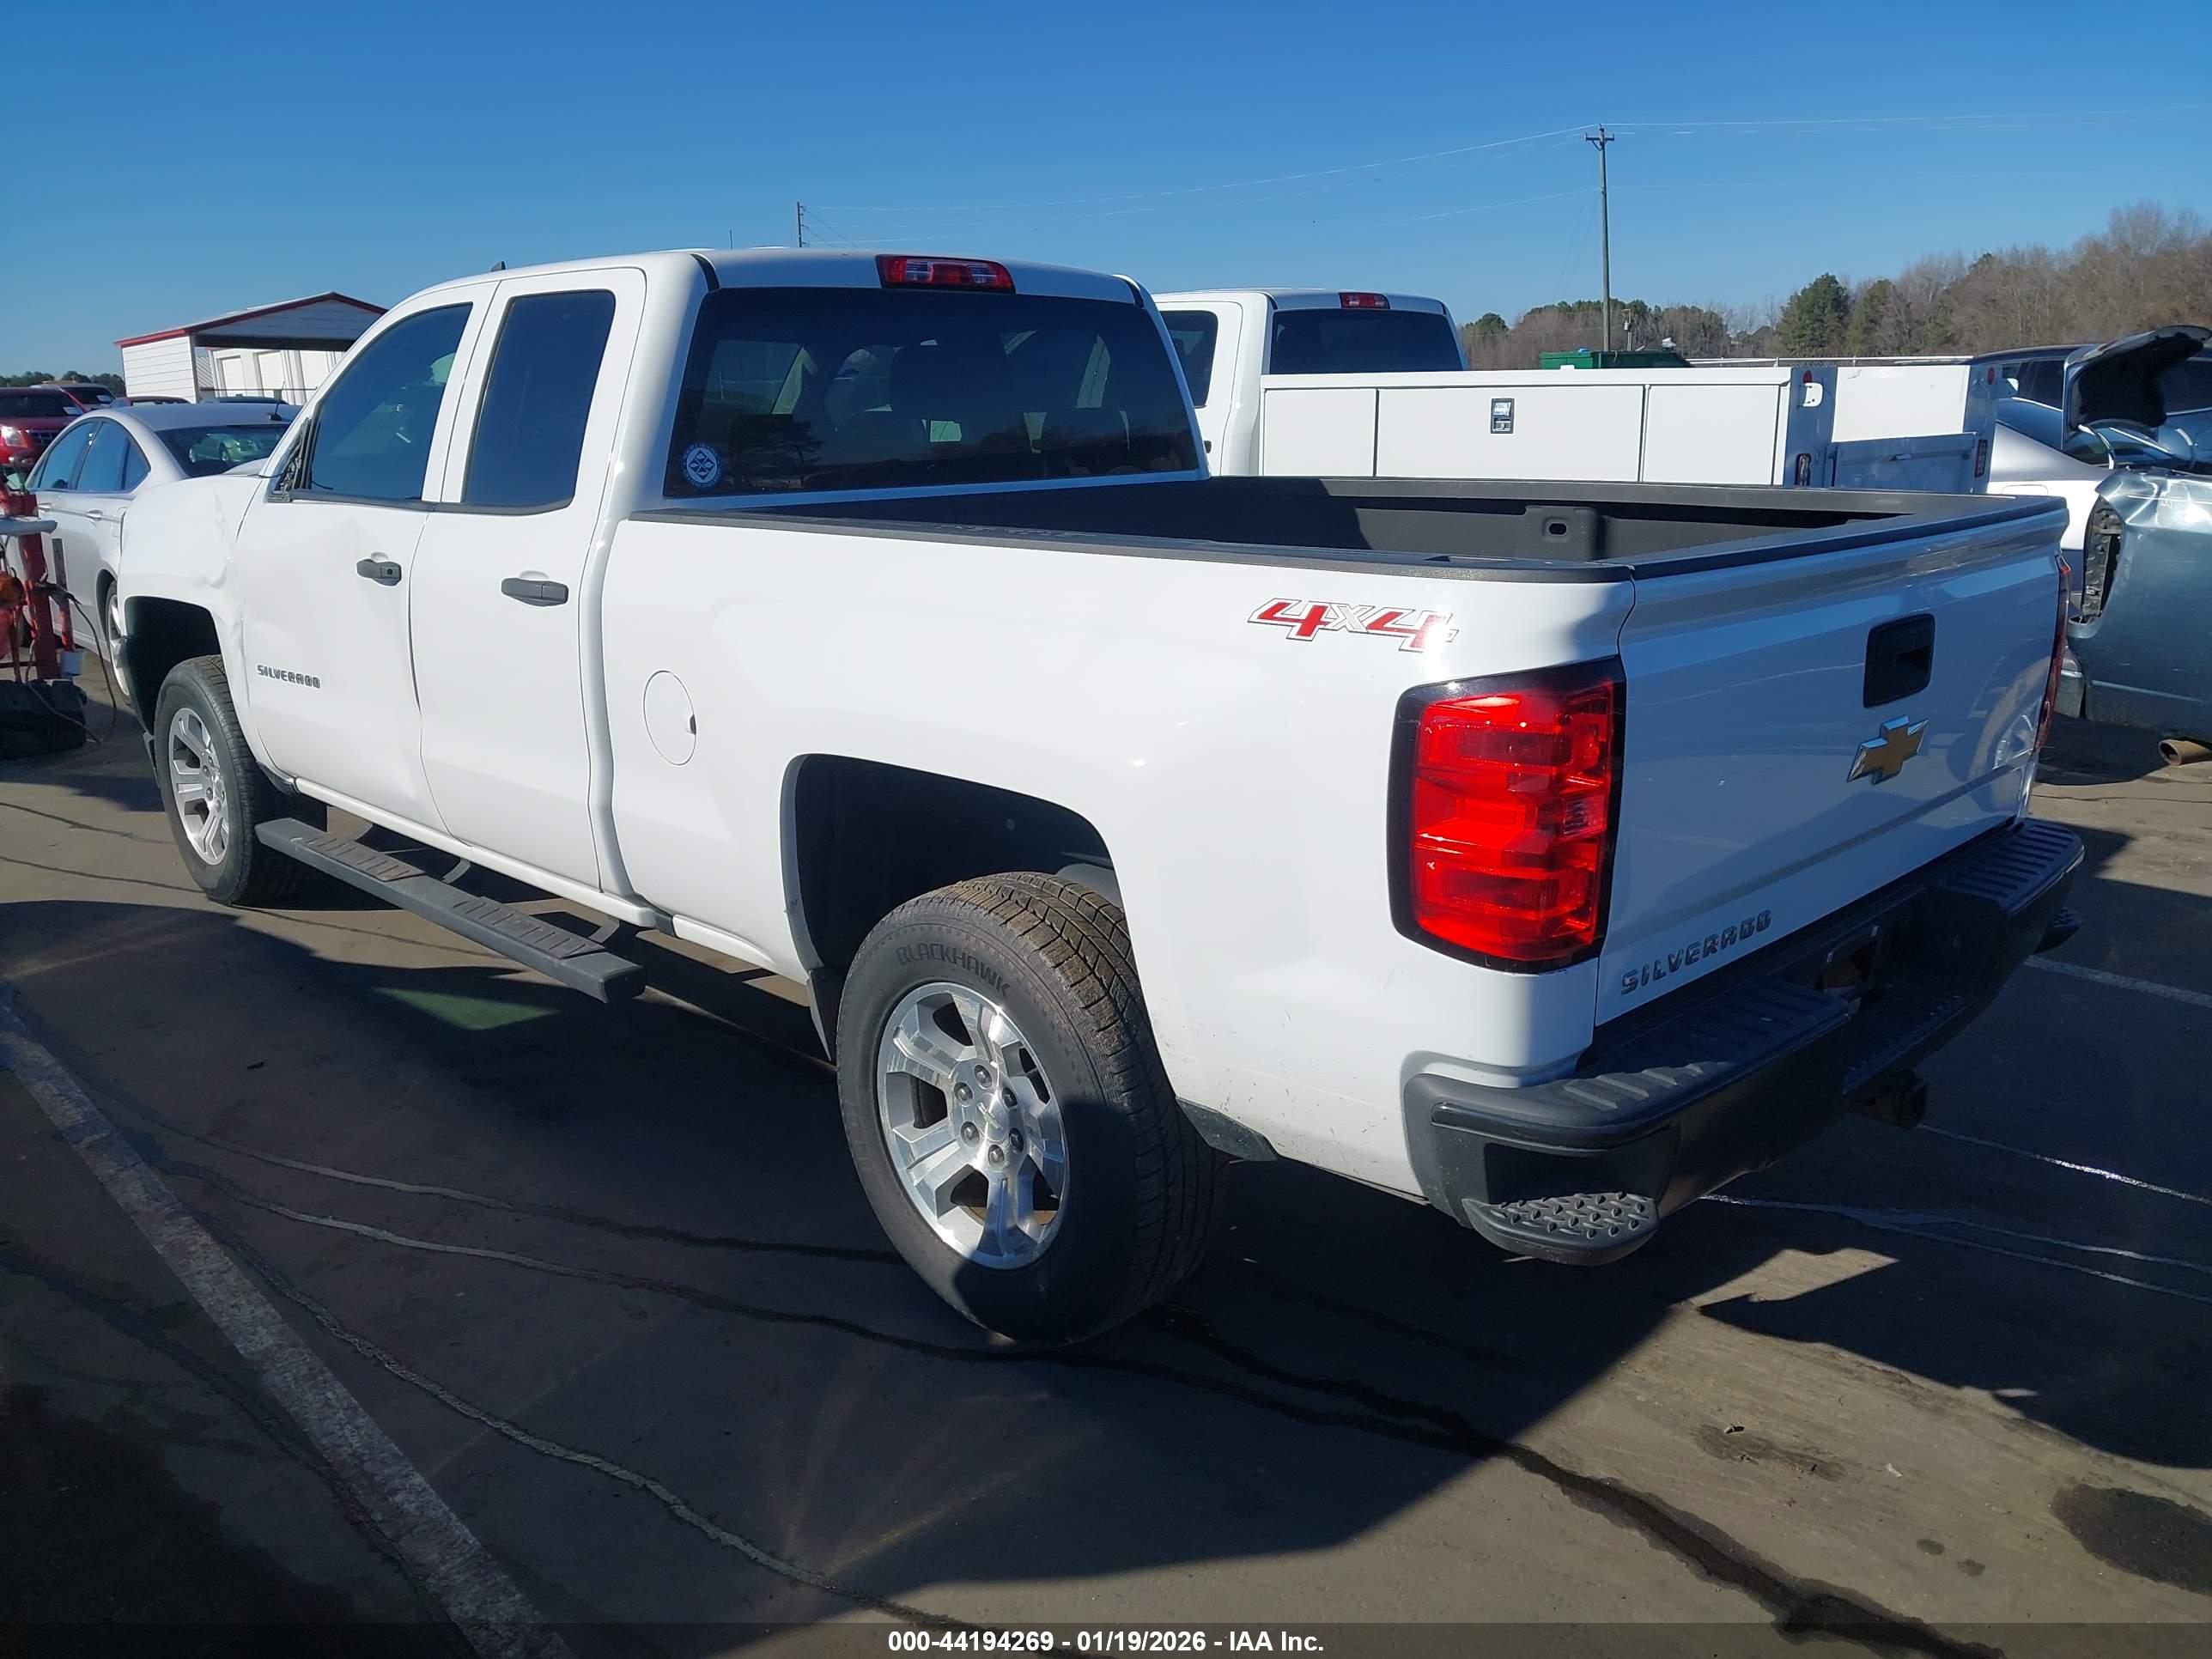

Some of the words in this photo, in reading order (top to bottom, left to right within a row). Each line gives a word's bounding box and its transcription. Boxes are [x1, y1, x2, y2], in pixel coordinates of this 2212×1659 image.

[257, 665, 321, 690] SILVERADO
[896, 943, 1011, 997] BLACKHAWK
[1620, 909, 1772, 995] SILVERADO
